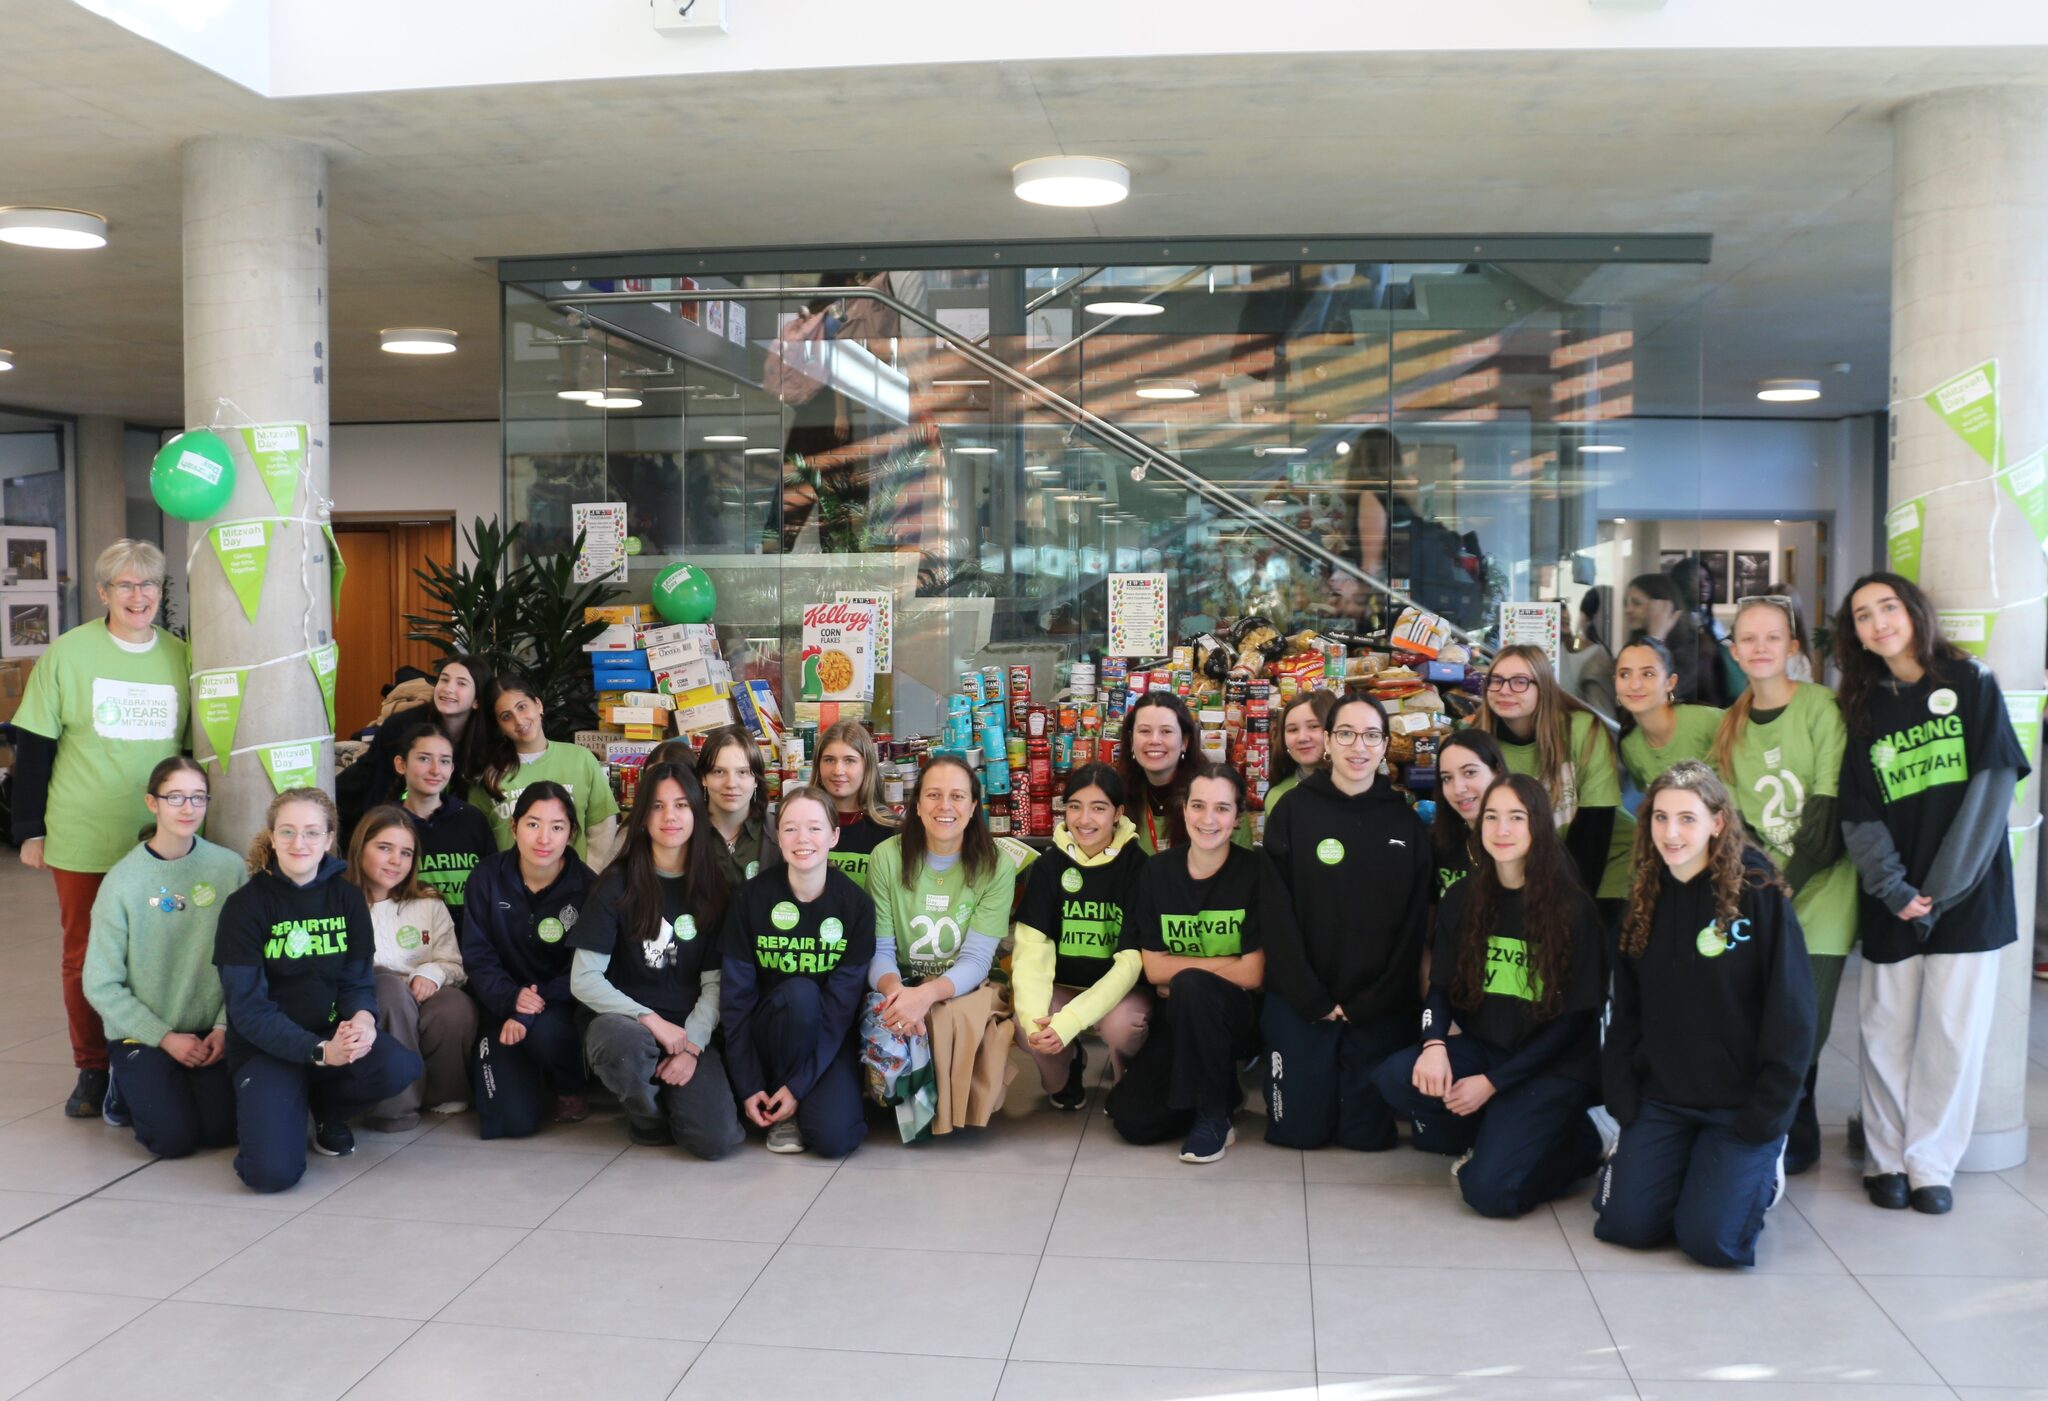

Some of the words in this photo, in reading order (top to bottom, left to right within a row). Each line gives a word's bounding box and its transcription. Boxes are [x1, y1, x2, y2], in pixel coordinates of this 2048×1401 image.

[256, 428, 297, 440] Mitzvah
[257, 438, 277, 449] Day
[222, 525, 261, 538] Mitzvah
[222, 534, 241, 547] Day
[820, 628, 842, 637] CORN
[200, 675, 236, 687] Mitzvah
[200, 686, 217, 696] Day
[106, 696, 168, 707] CELEBRATING
[123, 707, 168, 718] YEARS
[121, 719, 167, 728] MITZVAHS
[273, 747, 311, 759] Mitzvah
[274, 759, 294, 768] Day
[757, 935, 816, 951] REPAIR
[909, 914, 962, 961] 20
[1169, 939, 1204, 956] Da
